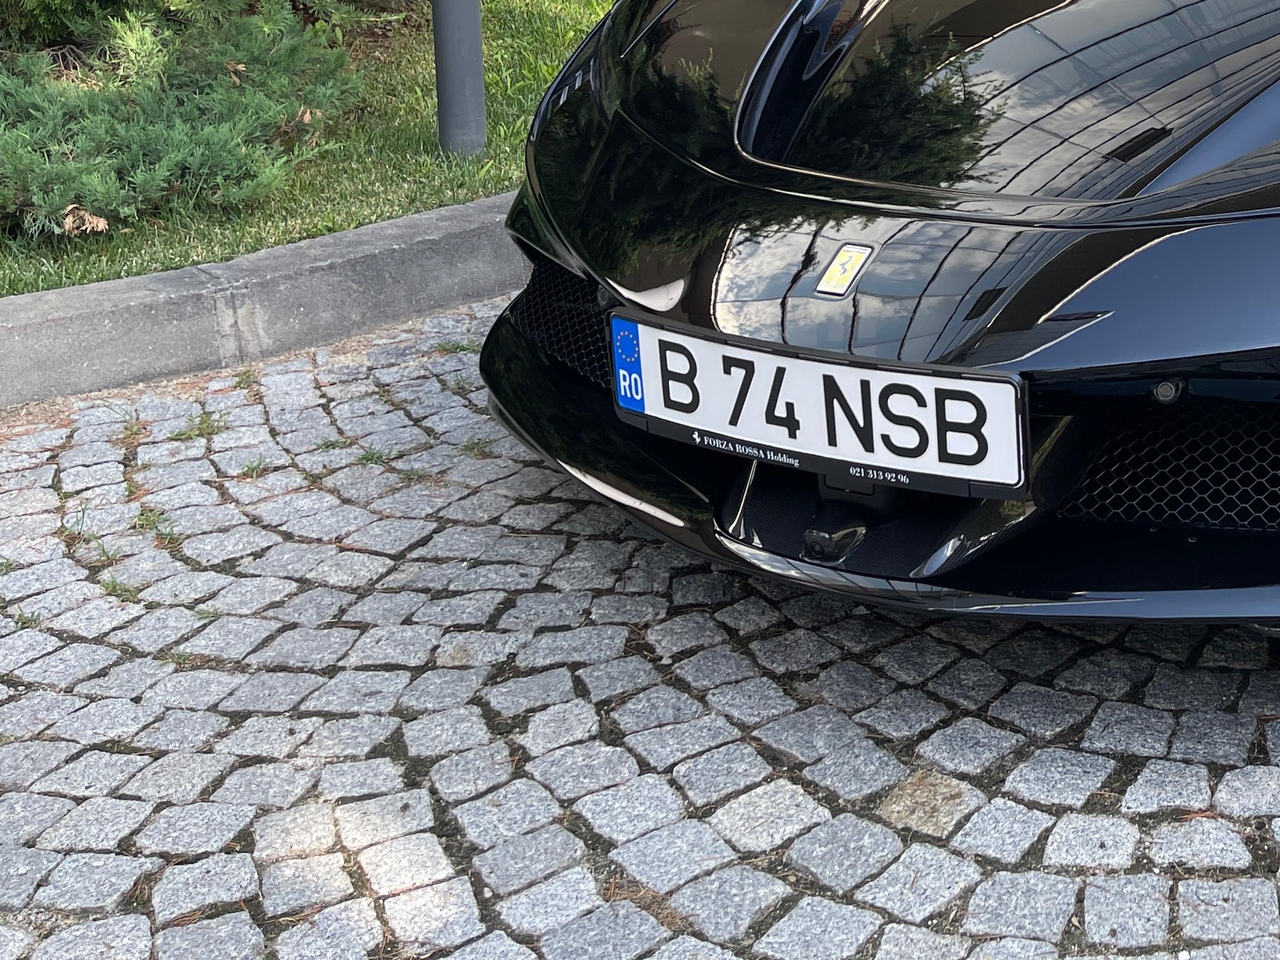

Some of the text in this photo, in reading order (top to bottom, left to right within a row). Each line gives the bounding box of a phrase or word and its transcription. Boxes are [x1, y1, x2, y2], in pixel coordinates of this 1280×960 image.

[619, 369, 642, 400] RO
[658, 339, 988, 465] B 74 NSB
[703, 436, 800, 468] FORZA ROSSA Holding
[849, 466, 865, 477] 021
[867, 469, 884, 480] 313
[885, 472, 897, 482] 92
